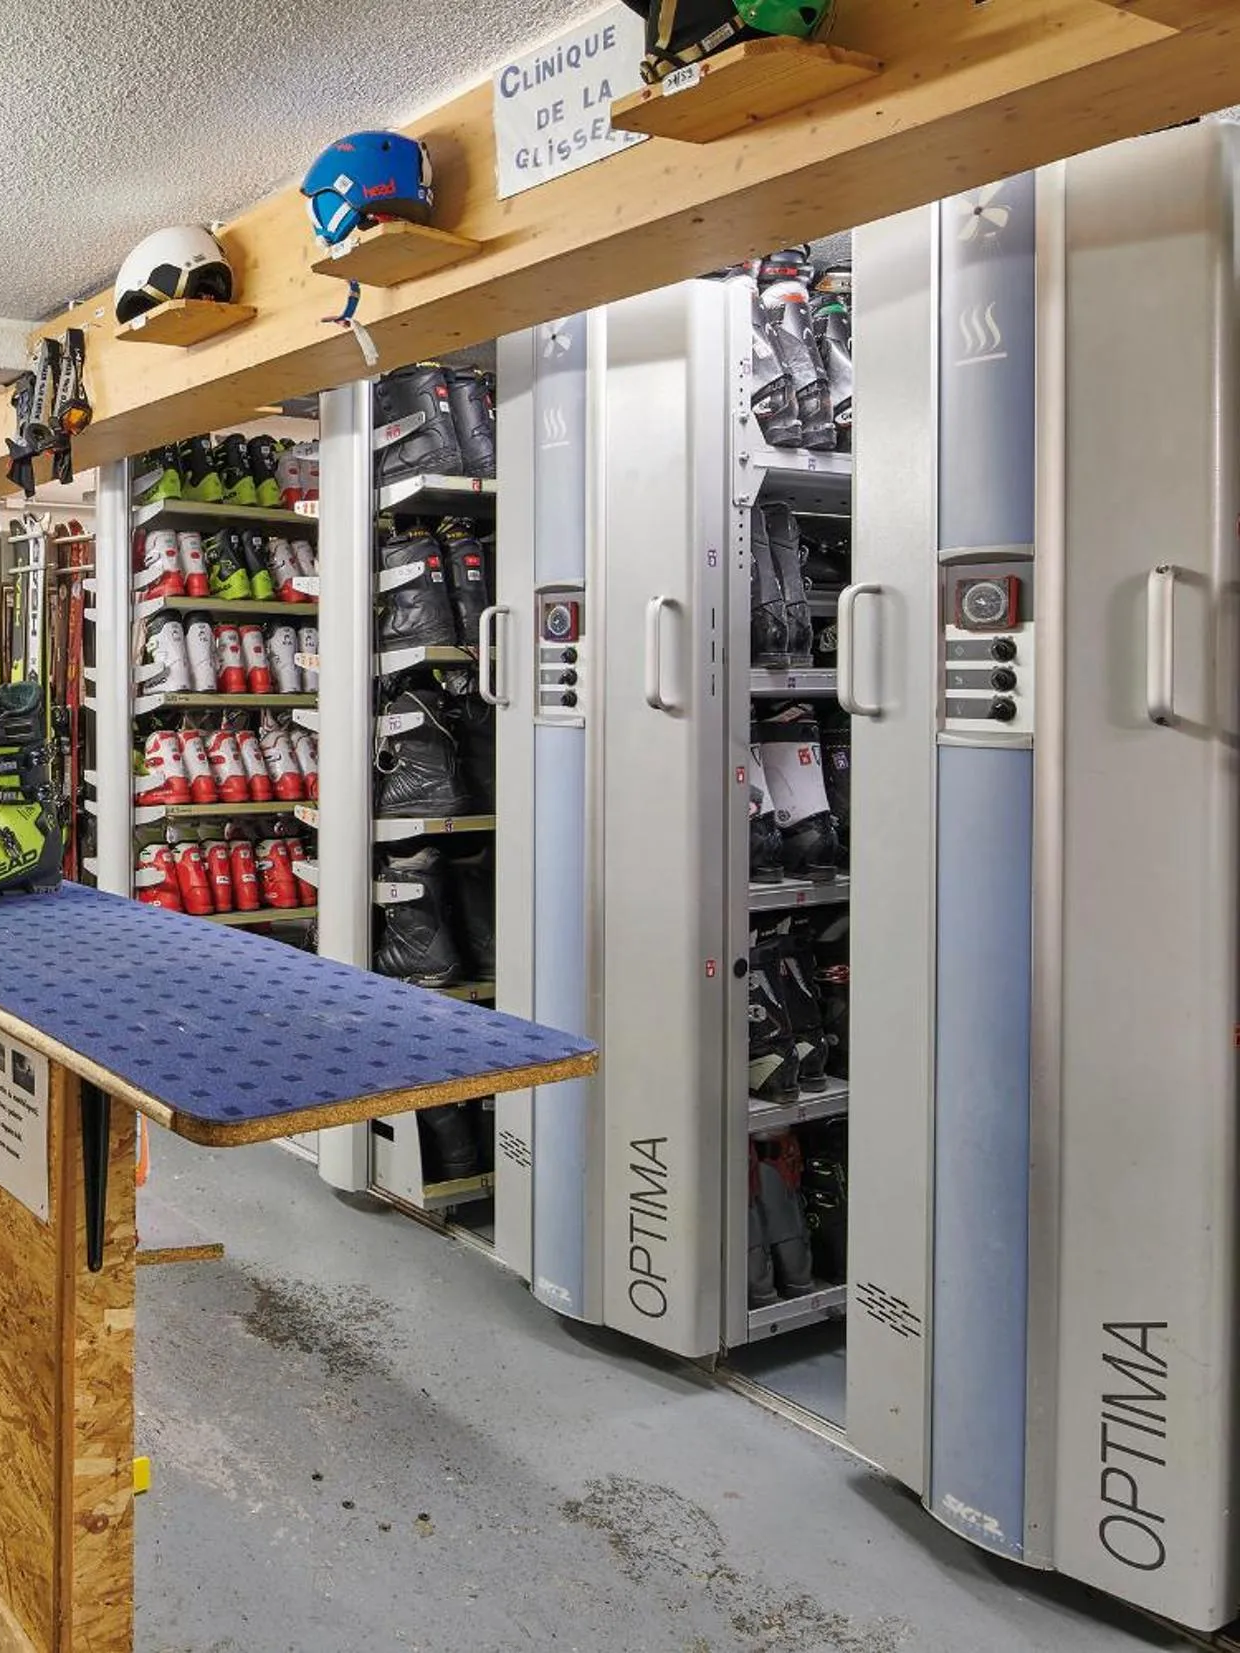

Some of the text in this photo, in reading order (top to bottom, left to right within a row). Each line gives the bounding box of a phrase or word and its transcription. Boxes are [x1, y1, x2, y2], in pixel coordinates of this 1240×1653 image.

[536, 79, 613, 130] DE LA
[628, 1136, 668, 1319] OPTIMA
[1098, 1321, 1168, 1572] OPTIMA
